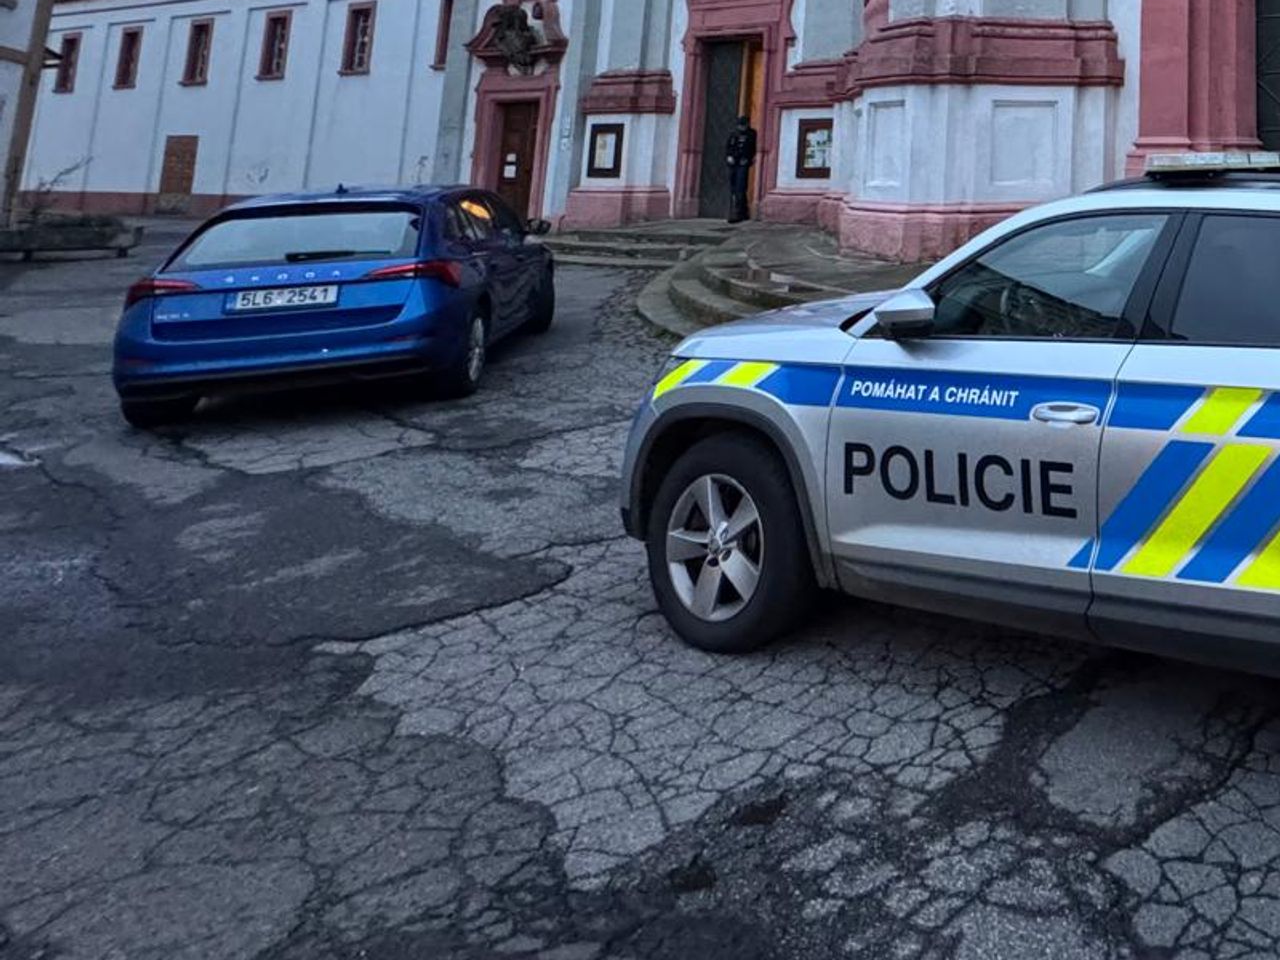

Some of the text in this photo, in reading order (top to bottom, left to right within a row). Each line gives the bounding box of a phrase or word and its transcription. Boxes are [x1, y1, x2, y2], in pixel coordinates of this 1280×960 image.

[240, 291, 274, 308] 5L6
[286, 287, 330, 304] 2541
[851, 379, 1019, 407] POMÁHAT A CHRÁNIT
[844, 442, 1077, 518] POLICIE
